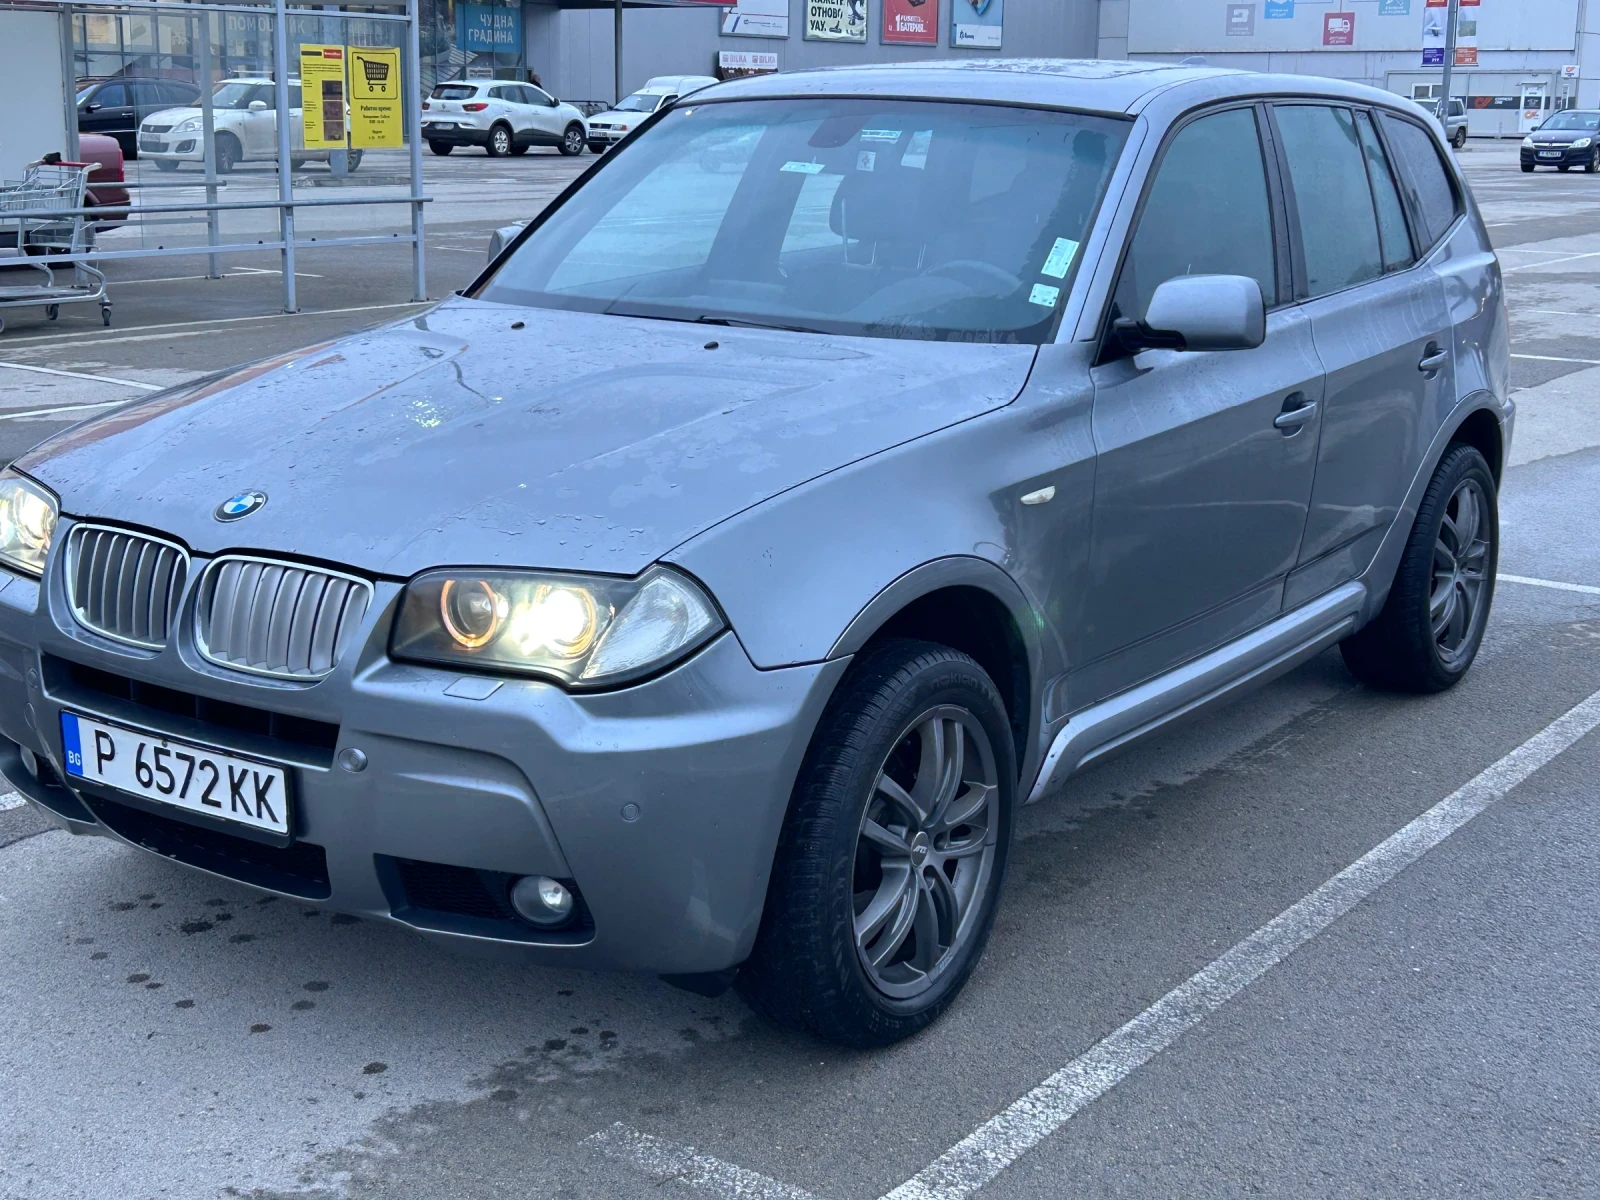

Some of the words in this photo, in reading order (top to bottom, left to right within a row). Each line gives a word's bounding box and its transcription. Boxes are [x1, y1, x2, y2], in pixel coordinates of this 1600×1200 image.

[811, 6, 843, 19] ОТНОВО
[228, 15, 305, 34] ПОМОИК
[480, 13, 514, 29] ЧУДНА
[468, 28, 514, 44] ГРАДИНА
[729, 54, 747, 64] BILKA
[759, 55, 776, 64] BILKA
[68, 750, 82, 767] BG
[94, 729, 116, 776] P
[135, 742, 281, 824] 6572KK
